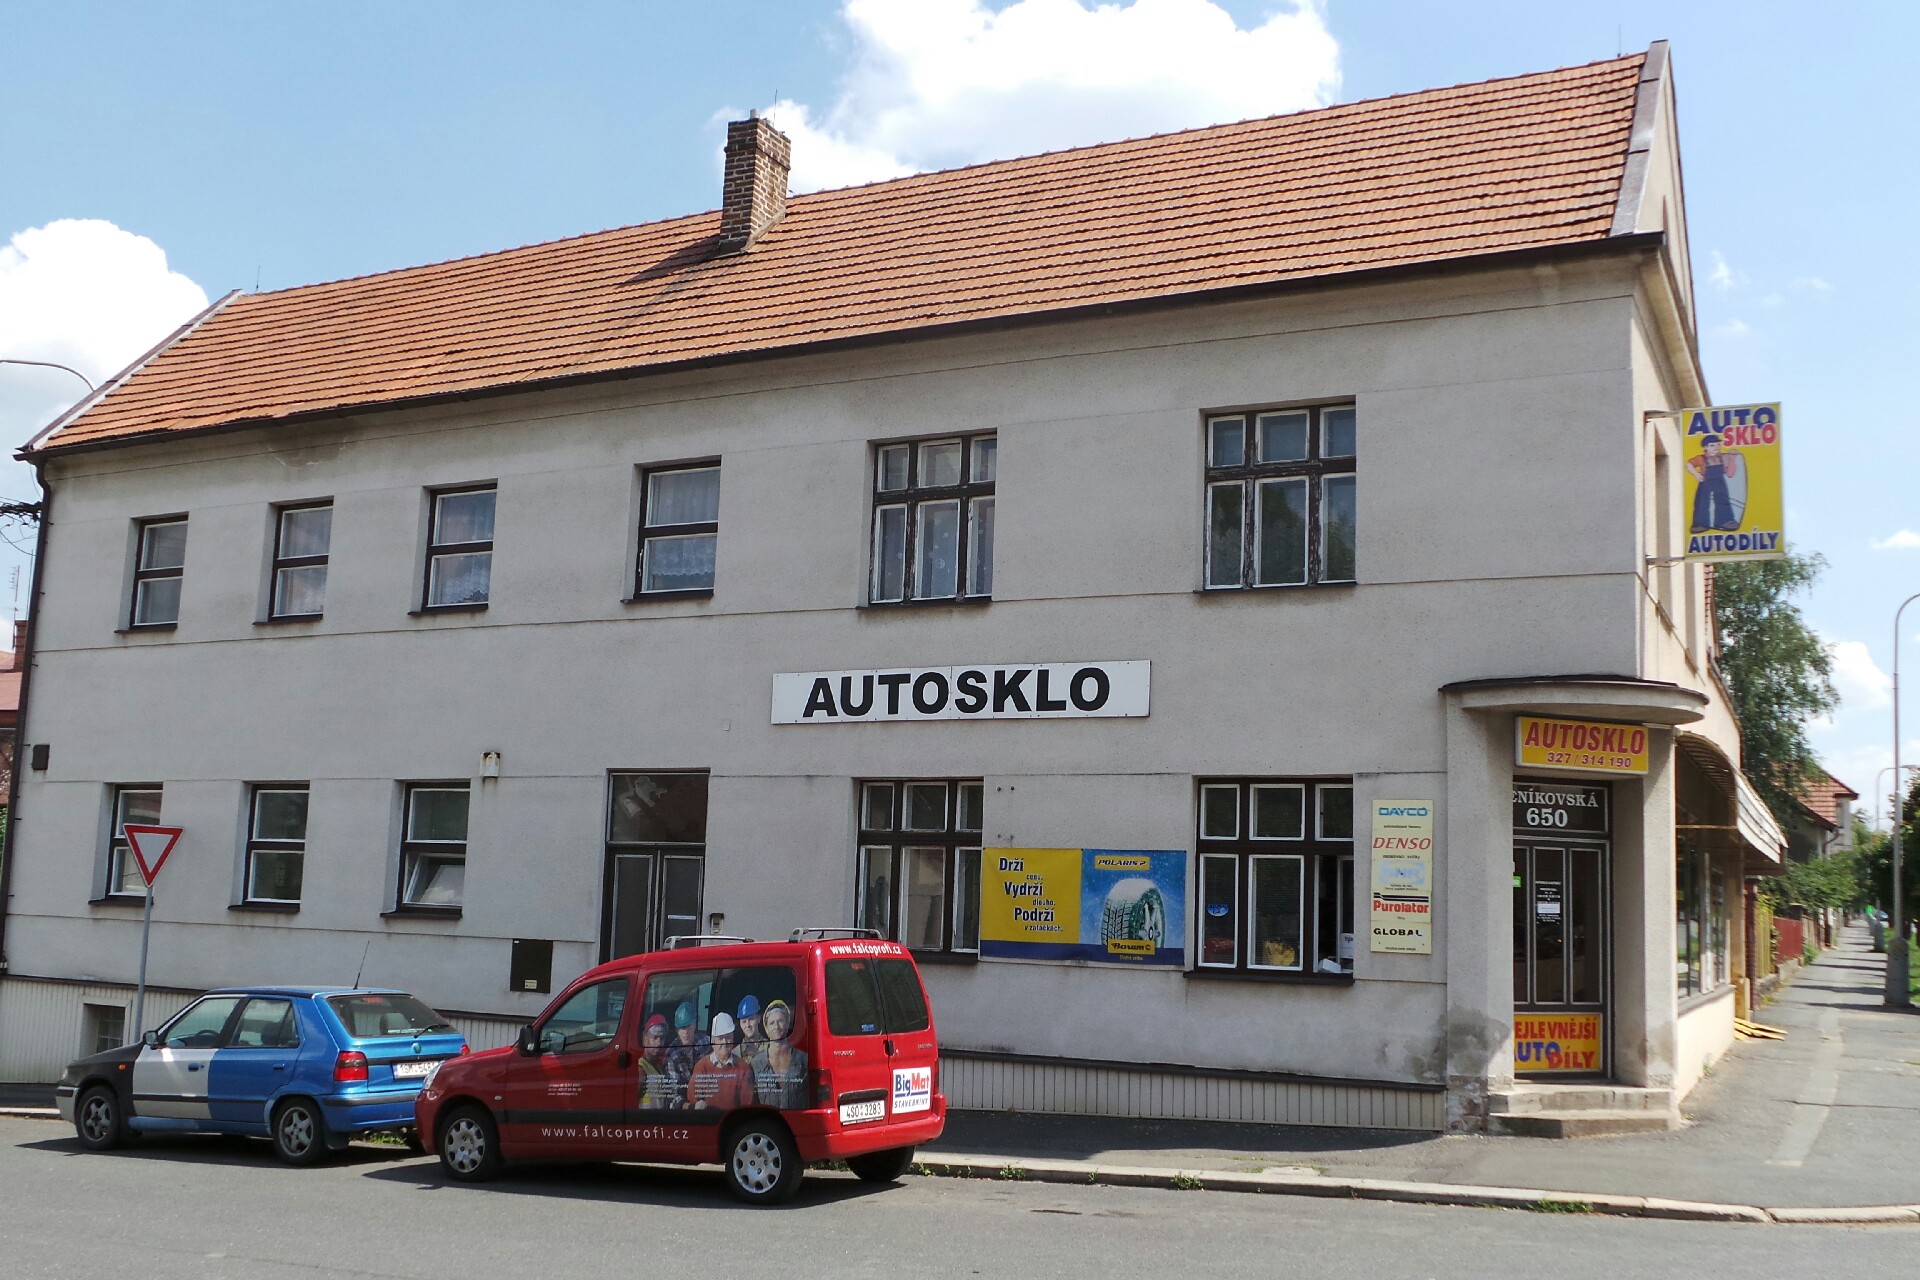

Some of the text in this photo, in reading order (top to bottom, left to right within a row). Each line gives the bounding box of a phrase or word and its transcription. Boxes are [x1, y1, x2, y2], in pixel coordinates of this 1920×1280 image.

[1688, 406, 1777, 435] AUTO
[1722, 423, 1777, 447] SKLO
[1688, 527, 1779, 553] AUTODÍLY
[802, 667, 1111, 718] AUTOSKLO
[1524, 721, 1646, 755] AUTOSKLO
[1609, 757, 1632, 767] 190
[1379, 807, 1429, 817] DAYCO
[1526, 807, 1568, 827] 650
[1372, 836, 1432, 850] DENSO
[1000, 858, 1024, 871] Drží
[1004, 882, 1043, 898] Vydrží
[1014, 907, 1054, 921] Podrží
[1373, 900, 1429, 913] Purolator
[1373, 928, 1423, 937] GLOBAL
[829, 943, 902, 957] www.falcoprofi.cz
[1514, 1041, 1560, 1062] UTO
[1548, 1045, 1595, 1068] DÍLY
[895, 1072, 930, 1097] BigMat
[541, 1125, 689, 1141] www.falcoprofi.cz
